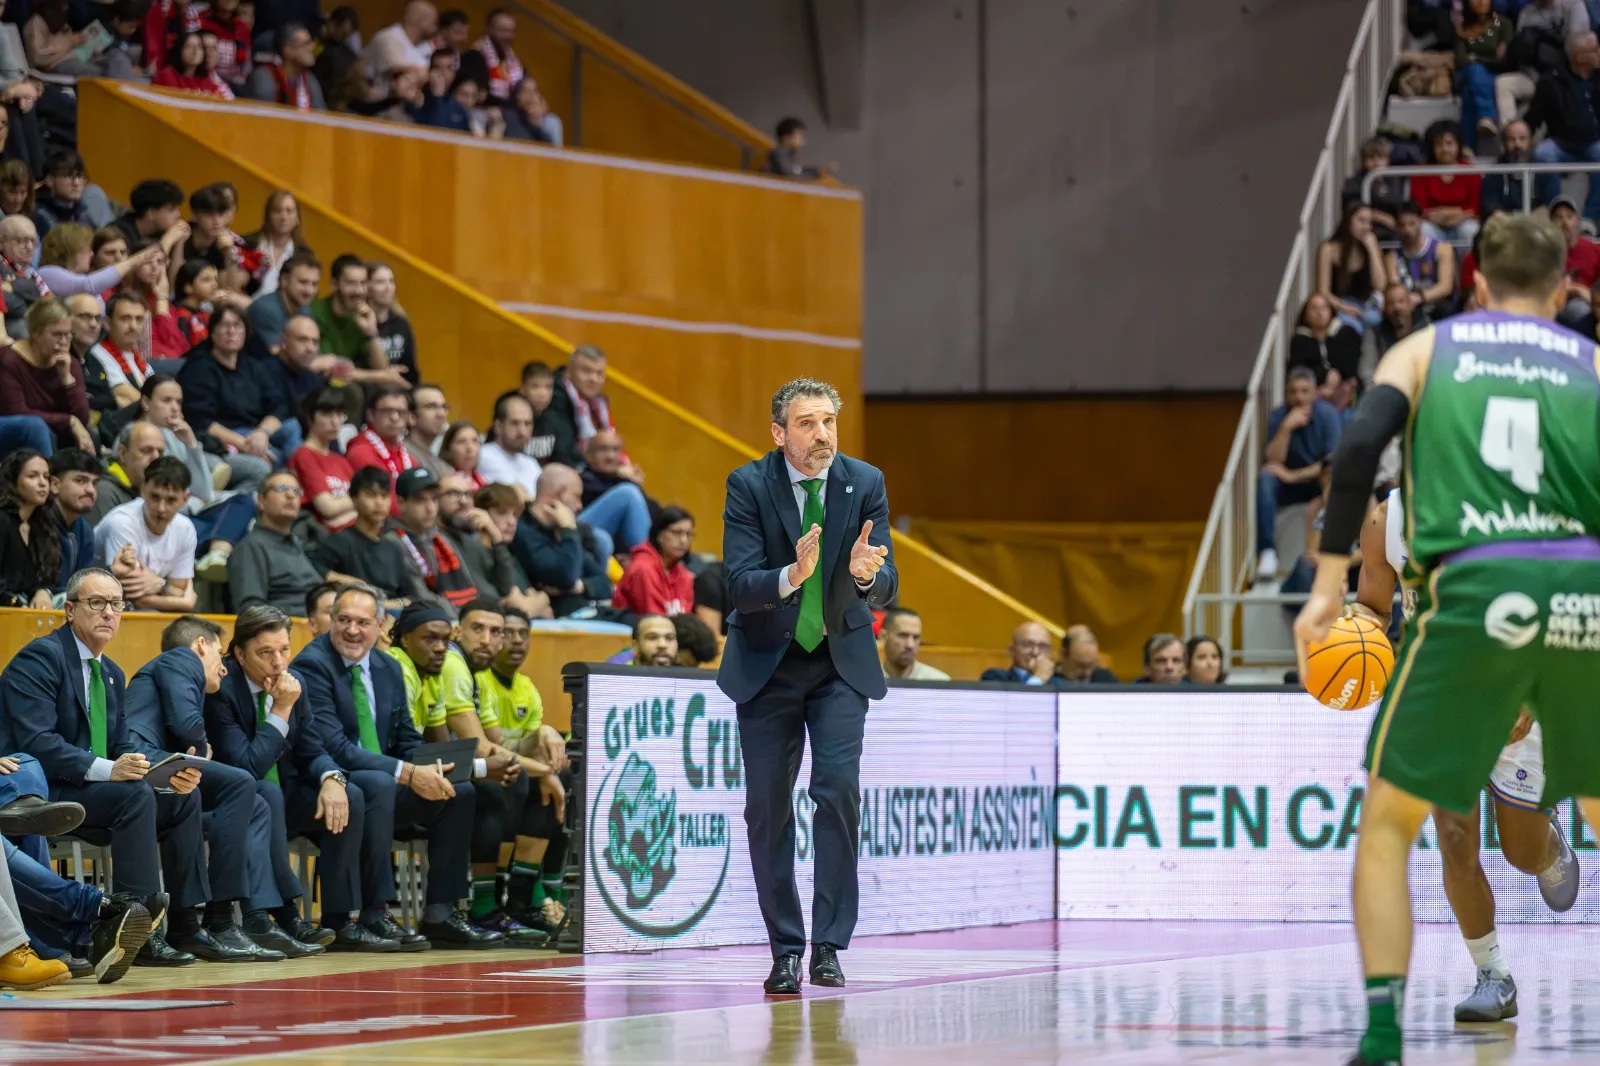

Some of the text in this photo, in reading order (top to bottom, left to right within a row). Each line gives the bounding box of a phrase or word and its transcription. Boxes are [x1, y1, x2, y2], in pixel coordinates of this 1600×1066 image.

[1480, 395, 1544, 495] 4
[604, 692, 747, 789] Grues Cru
[678, 813, 725, 847] TALLER
[942, 786, 967, 853] EN
[1178, 785, 1268, 849] EN
